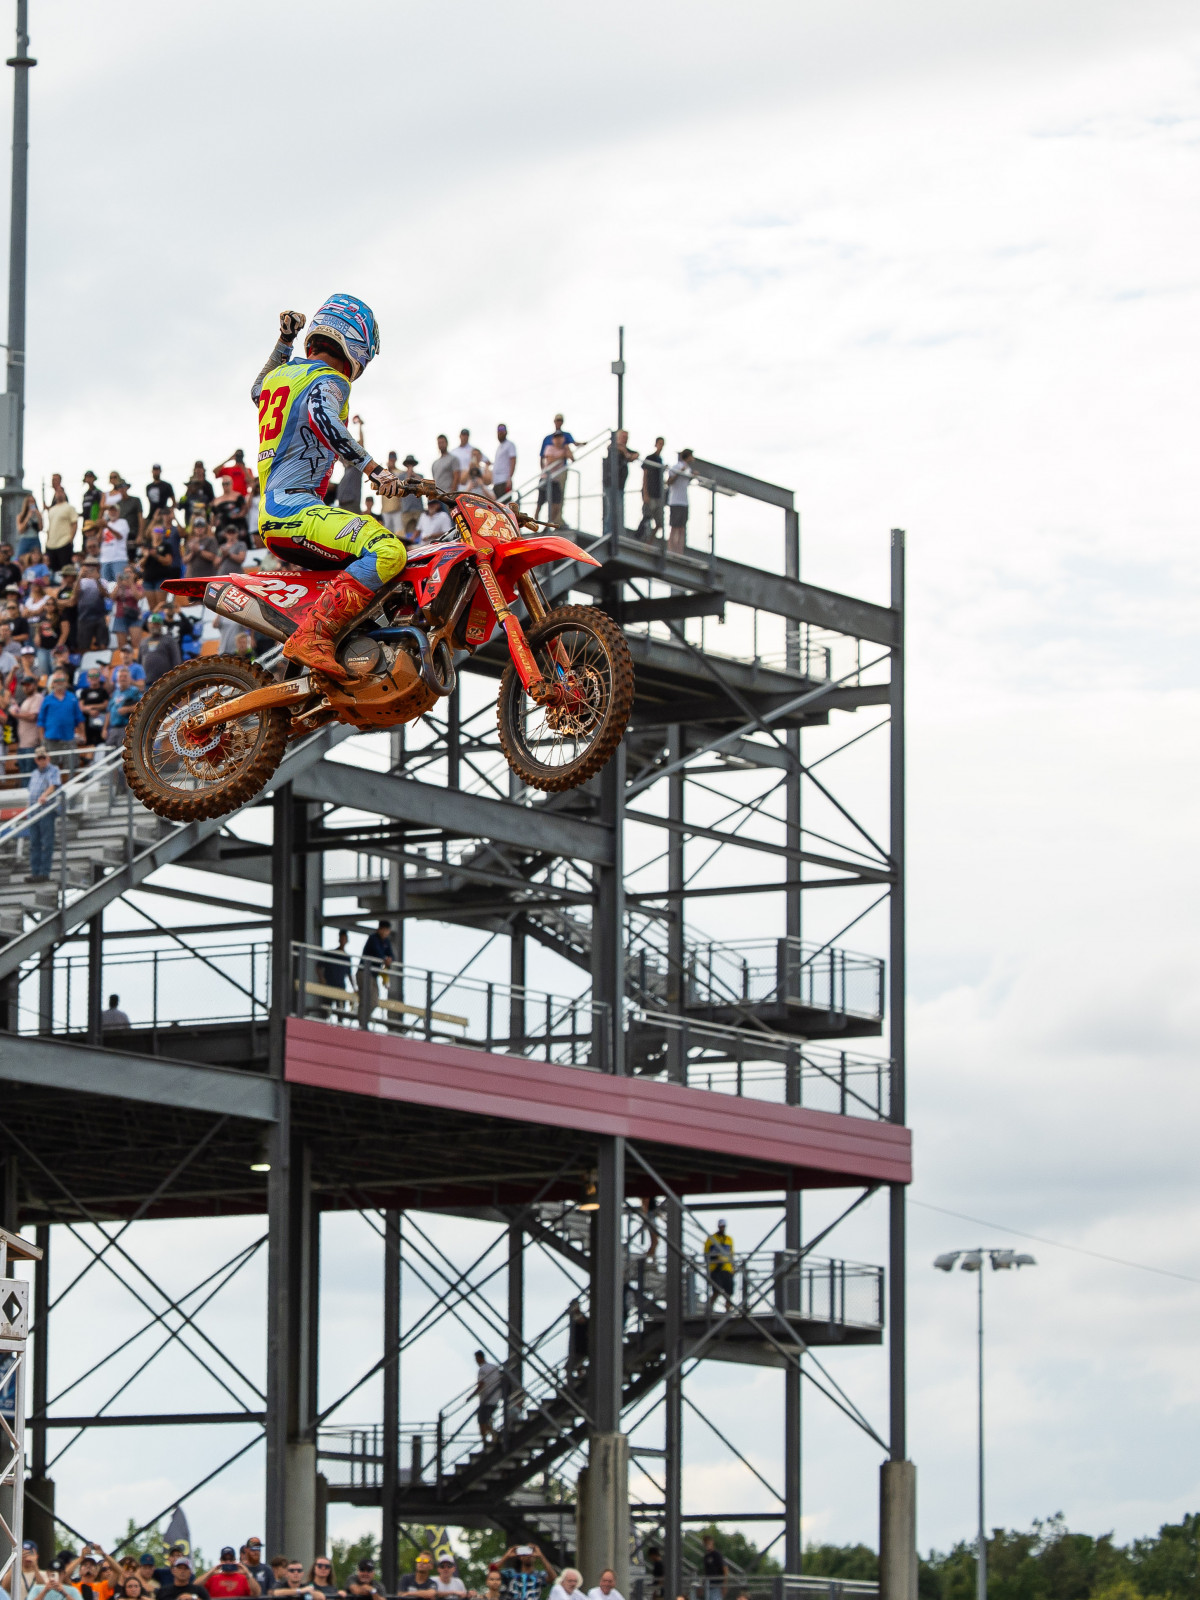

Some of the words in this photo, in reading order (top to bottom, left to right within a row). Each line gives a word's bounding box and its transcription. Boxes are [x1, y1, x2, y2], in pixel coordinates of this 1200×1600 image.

[259, 386, 290, 444] 23
[258, 448, 276, 462] NDA
[302, 540, 341, 560] HONDA
[244, 579, 309, 609] 23
